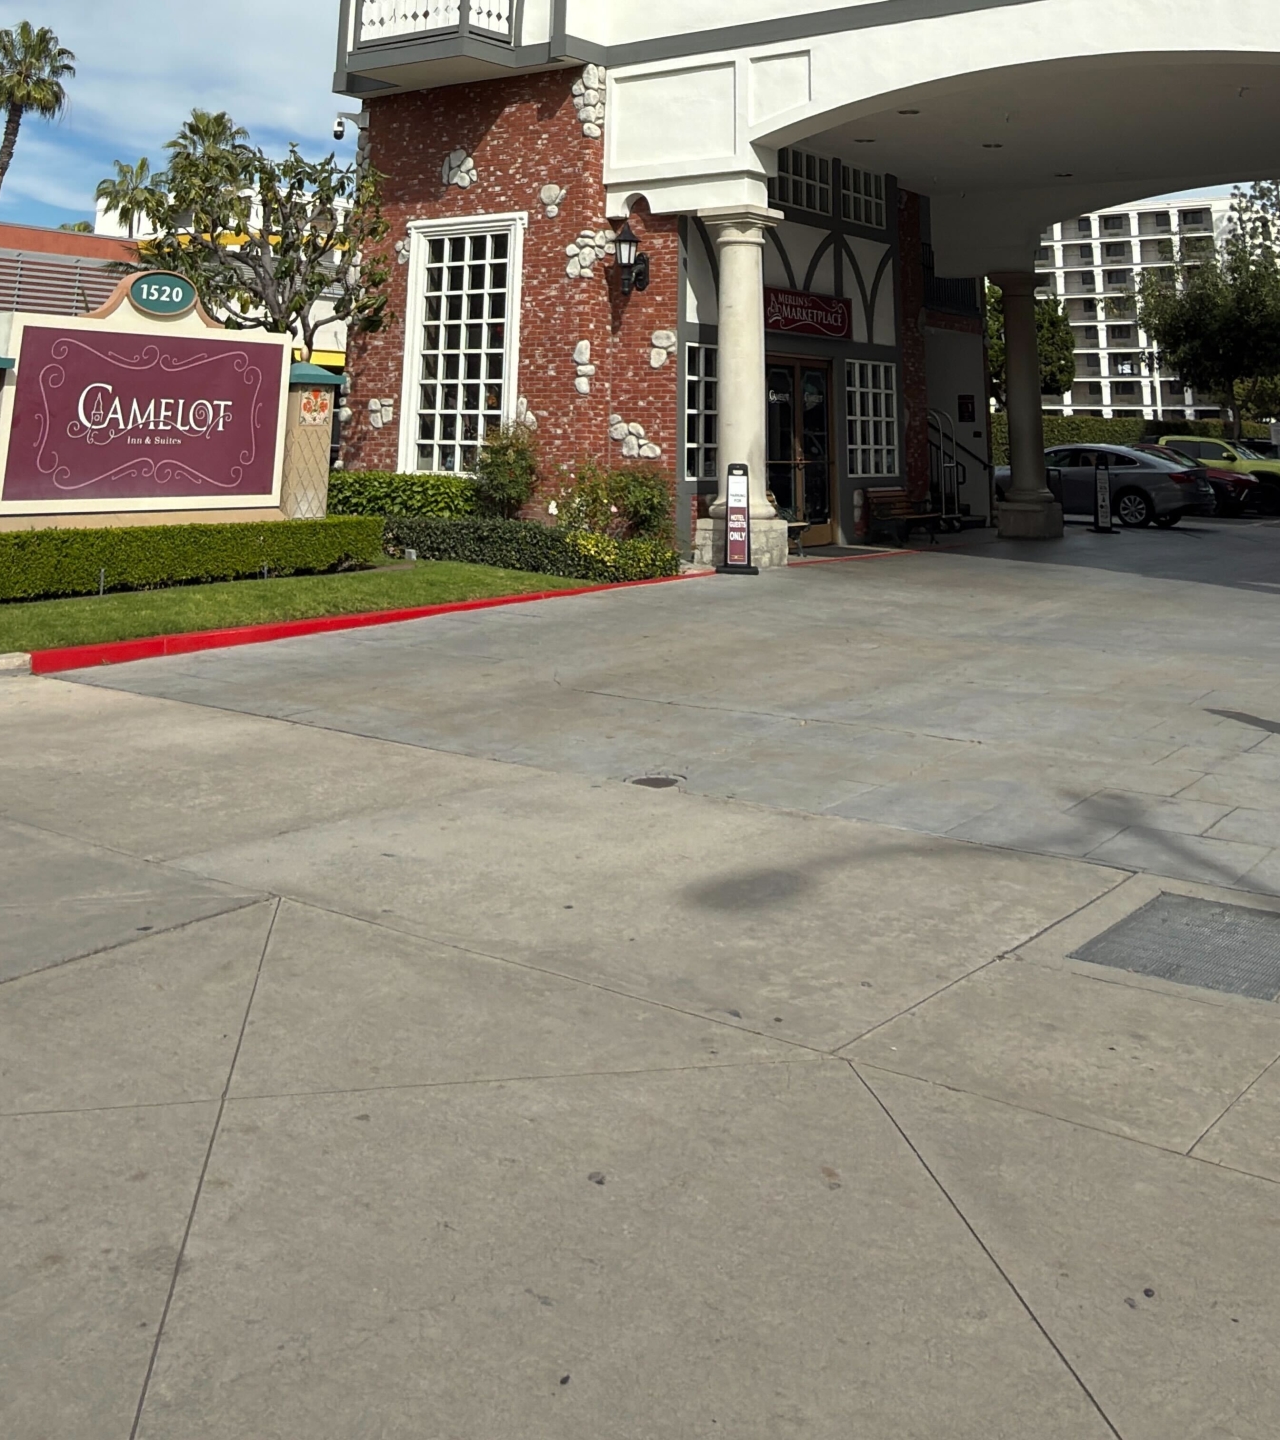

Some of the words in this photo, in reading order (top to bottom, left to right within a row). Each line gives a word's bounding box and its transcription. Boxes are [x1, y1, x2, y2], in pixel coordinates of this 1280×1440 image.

[140, 283, 183, 302] 1520
[778, 292, 808, 307] MERLIN'S
[781, 304, 842, 326] MARKETPLACE
[127, 436, 142, 444] Inn
[144, 436, 151, 444] &
[154, 436, 181, 445] Suites
[729, 531, 746, 541] ONLY
